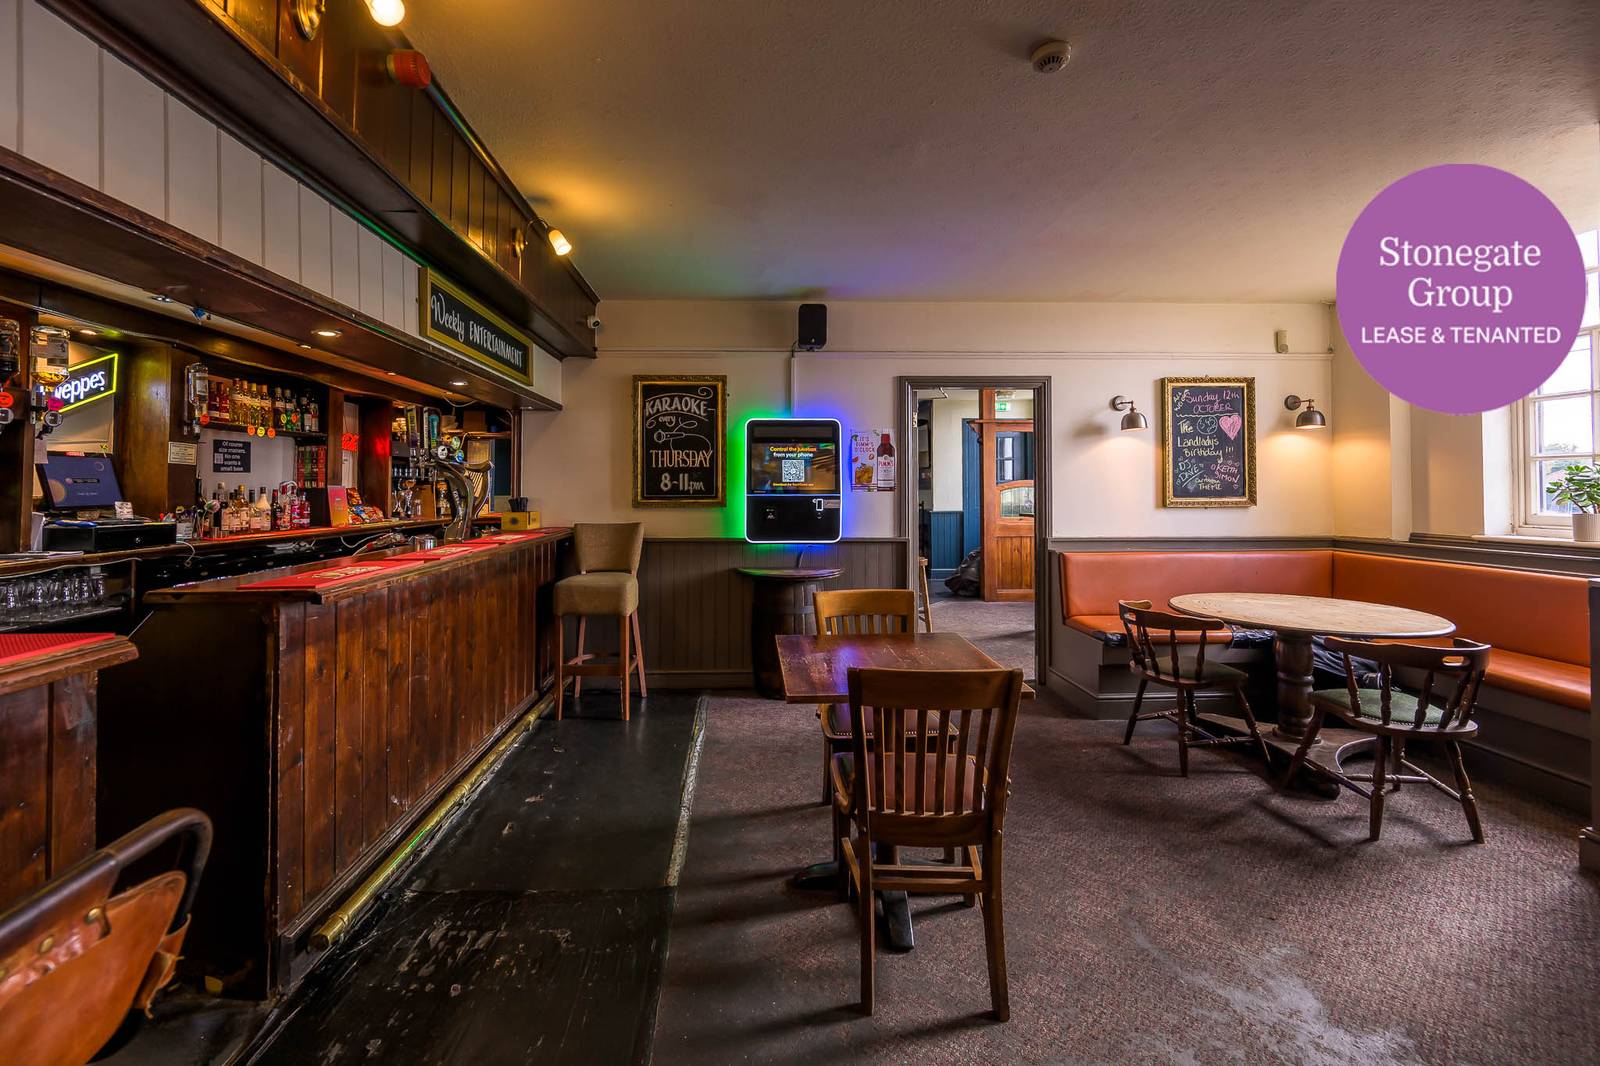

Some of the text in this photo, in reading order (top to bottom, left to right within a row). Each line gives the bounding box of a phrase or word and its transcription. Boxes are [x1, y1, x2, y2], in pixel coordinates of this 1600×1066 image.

[431, 293, 523, 368] Weekly ENTERTAINMENT
[645, 397, 708, 416] KARAOKE
[658, 415, 676, 427] every
[1177, 419, 1194, 434] The
[649, 449, 713, 468] THURSDAY
